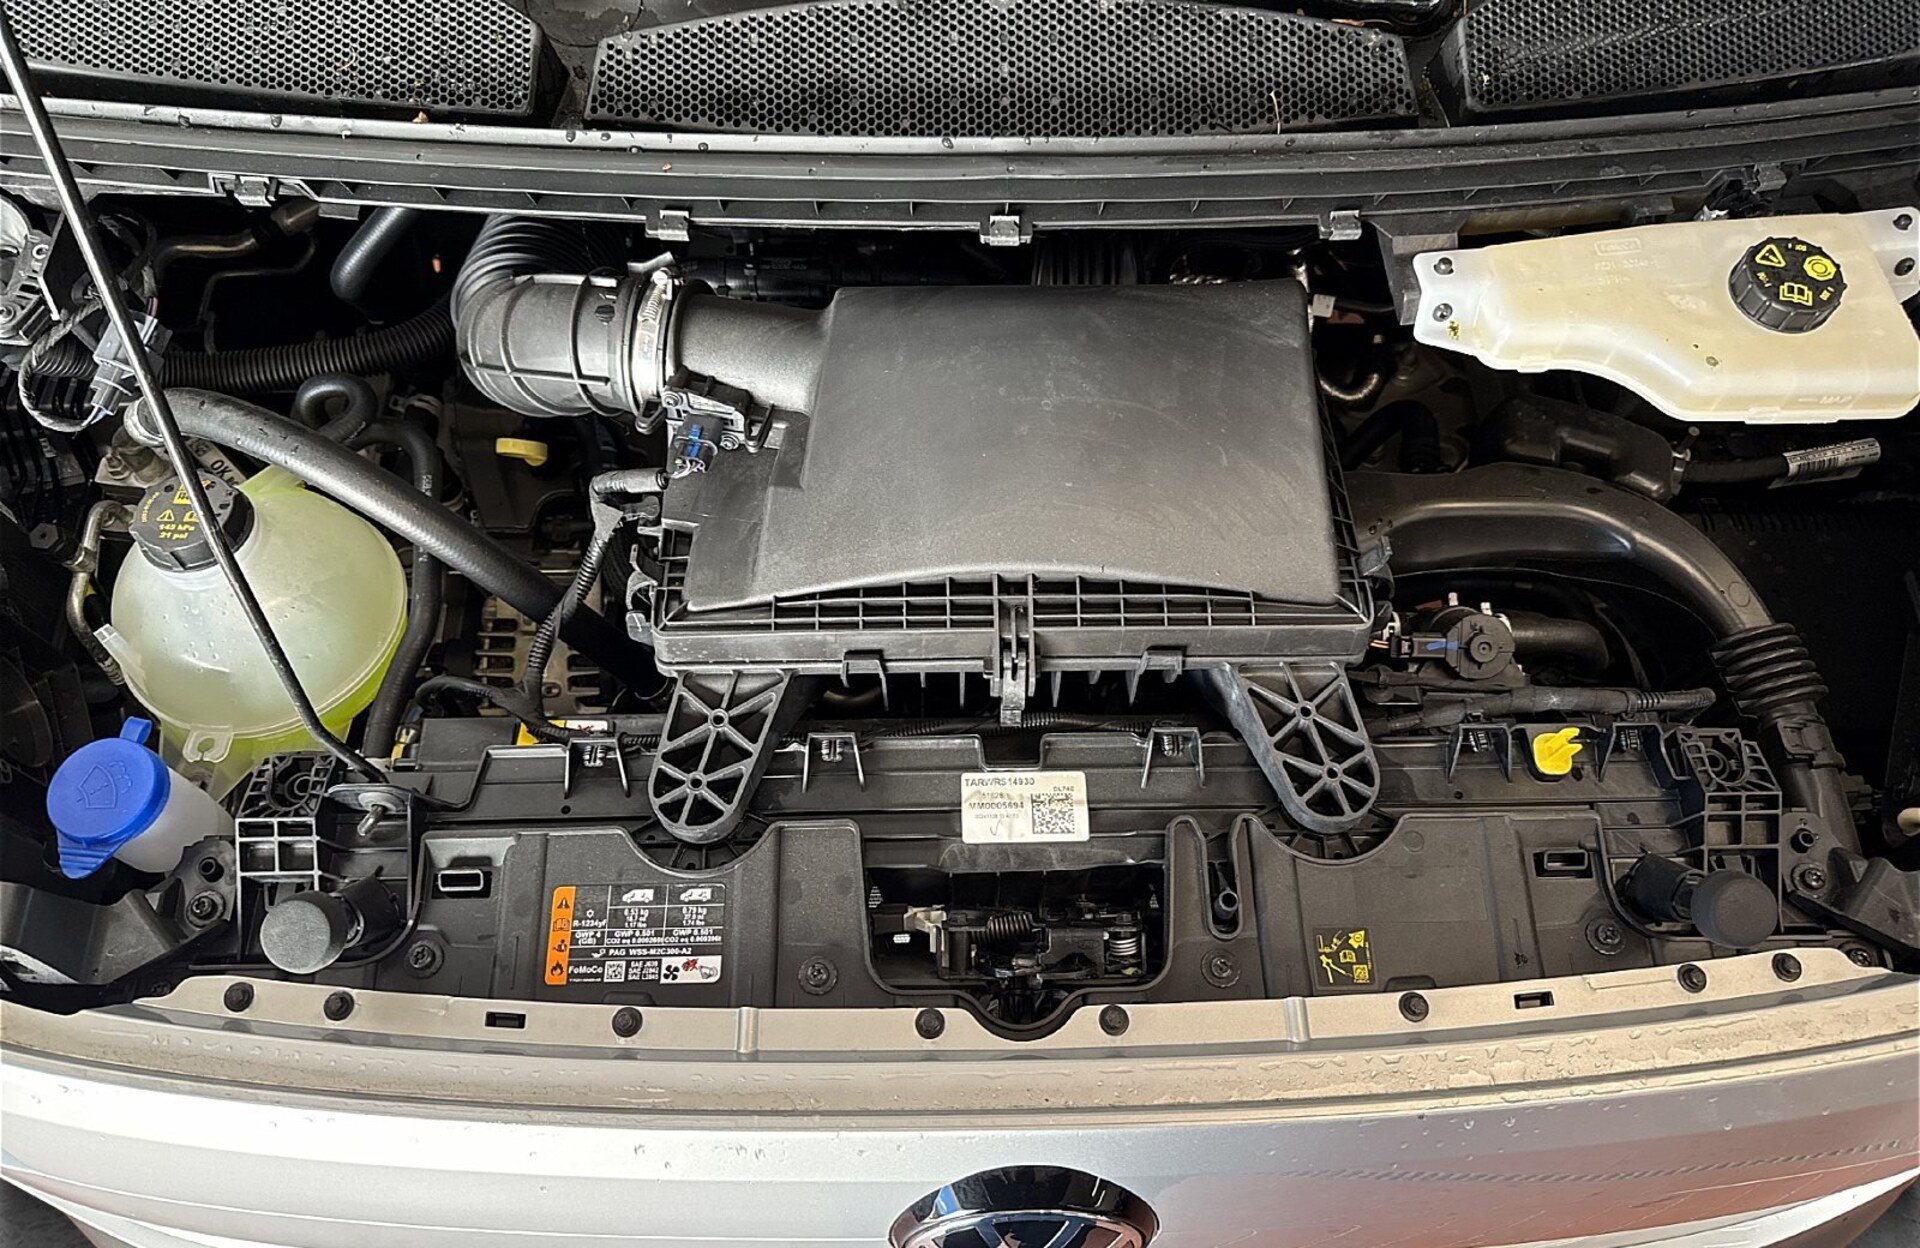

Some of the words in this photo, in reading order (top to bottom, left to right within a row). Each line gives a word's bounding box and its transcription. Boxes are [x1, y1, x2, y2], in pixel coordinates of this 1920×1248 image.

[210, 459, 232, 478] OK
[697, 906, 708, 916] kg
[572, 918, 607, 929] R-1234yf
[608, 948, 626, 956] PAG
[629, 947, 692, 956] WSS-M2C300-A2
[568, 965, 603, 974] FoMoCo
